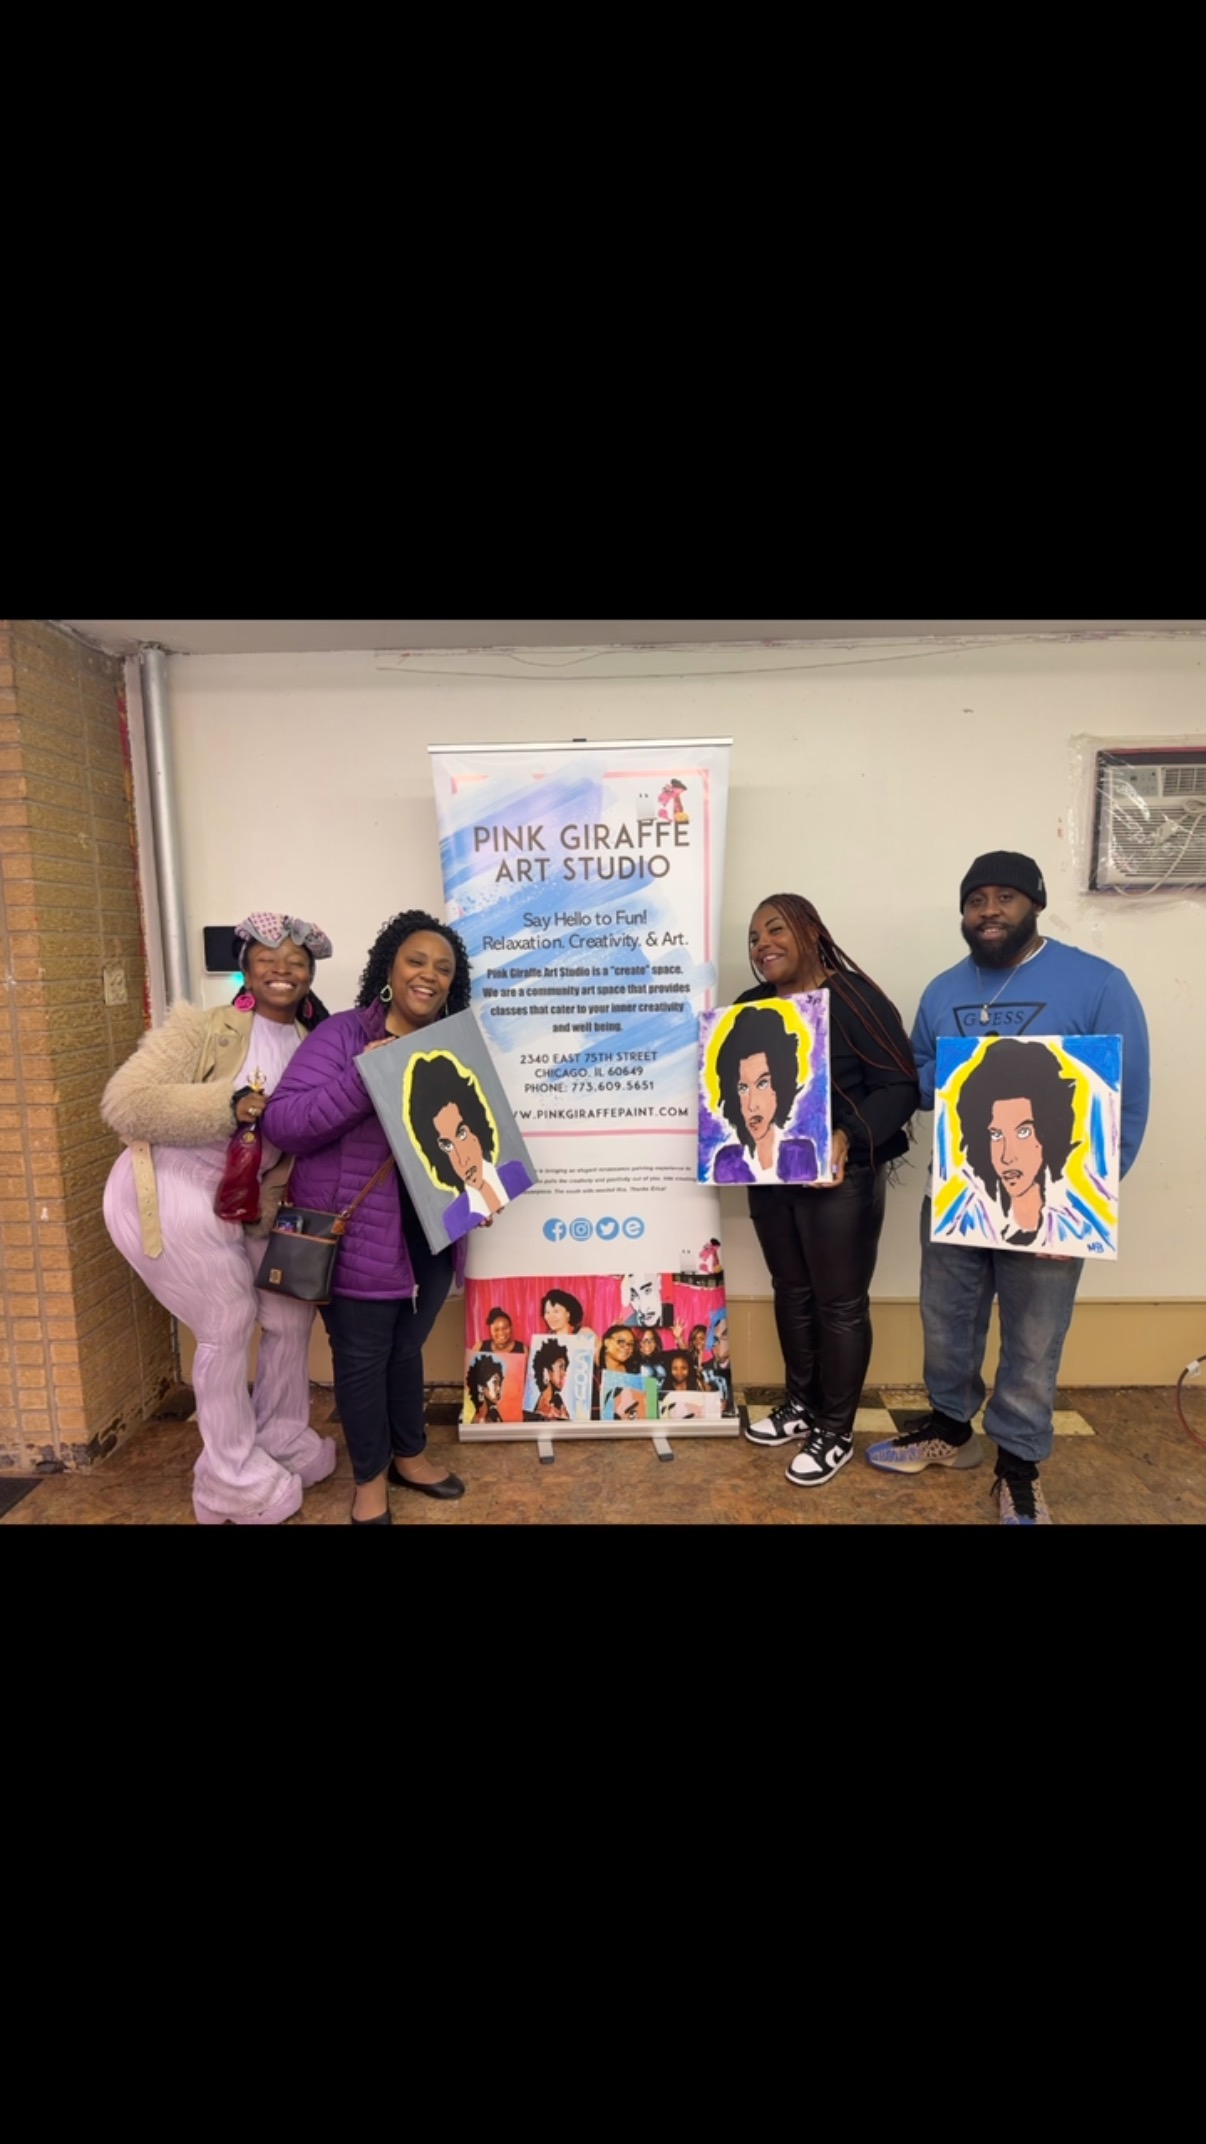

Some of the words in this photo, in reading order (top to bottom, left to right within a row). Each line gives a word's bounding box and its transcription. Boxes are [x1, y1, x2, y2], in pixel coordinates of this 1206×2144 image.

[473, 825, 546, 853] PINK
[559, 819, 691, 850] GIRAFFE
[495, 856, 551, 882] ART
[563, 854, 671, 880] STUDIO
[523, 911, 551, 931] Say
[553, 910, 592, 928] Hello
[595, 911, 611, 926] to
[615, 909, 648, 926] Fun!
[646, 931, 659, 947] &
[661, 931, 690, 947] Art.
[487, 967, 508, 979] Pink
[510, 967, 543, 979] Giraffe
[543, 967, 559, 978] Art
[559, 966, 591, 978] Studio
[592, 966, 601, 977] is
[602, 967, 609, 976] a
[610, 965, 651, 976] "create"
[651, 964, 684, 976] space.
[482, 987, 498, 999] We
[500, 987, 517, 998] are
[518, 987, 525, 997] a
[525, 985, 580, 998] community
[580, 985, 596, 996] art
[597, 984, 626, 996] space
[627, 984, 647, 995] that
[648, 982, 691, 995] provides
[490, 1005, 528, 1017] classes
[528, 1004, 549, 1015] that
[550, 1004, 575, 1015] cater
[576, 1004, 587, 1015] to
[587, 1004, 610, 1015] your
[610, 1002, 637, 1013] inner
[638, 1001, 685, 1013] creativity
[552, 1022, 571, 1033] and
[572, 1021, 592, 1032] well
[593, 1021, 623, 1034] being.
[520, 1054, 550, 1065] 2340
[552, 1053, 581, 1065] EAST
[584, 1052, 613, 1064] 75TH
[616, 1051, 658, 1063] STREET
[594, 1067, 605, 1078] IL
[607, 1066, 644, 1078] 60649
[524, 1083, 568, 1094] PHONE:
[572, 1080, 655, 1093] 773.609.5651
